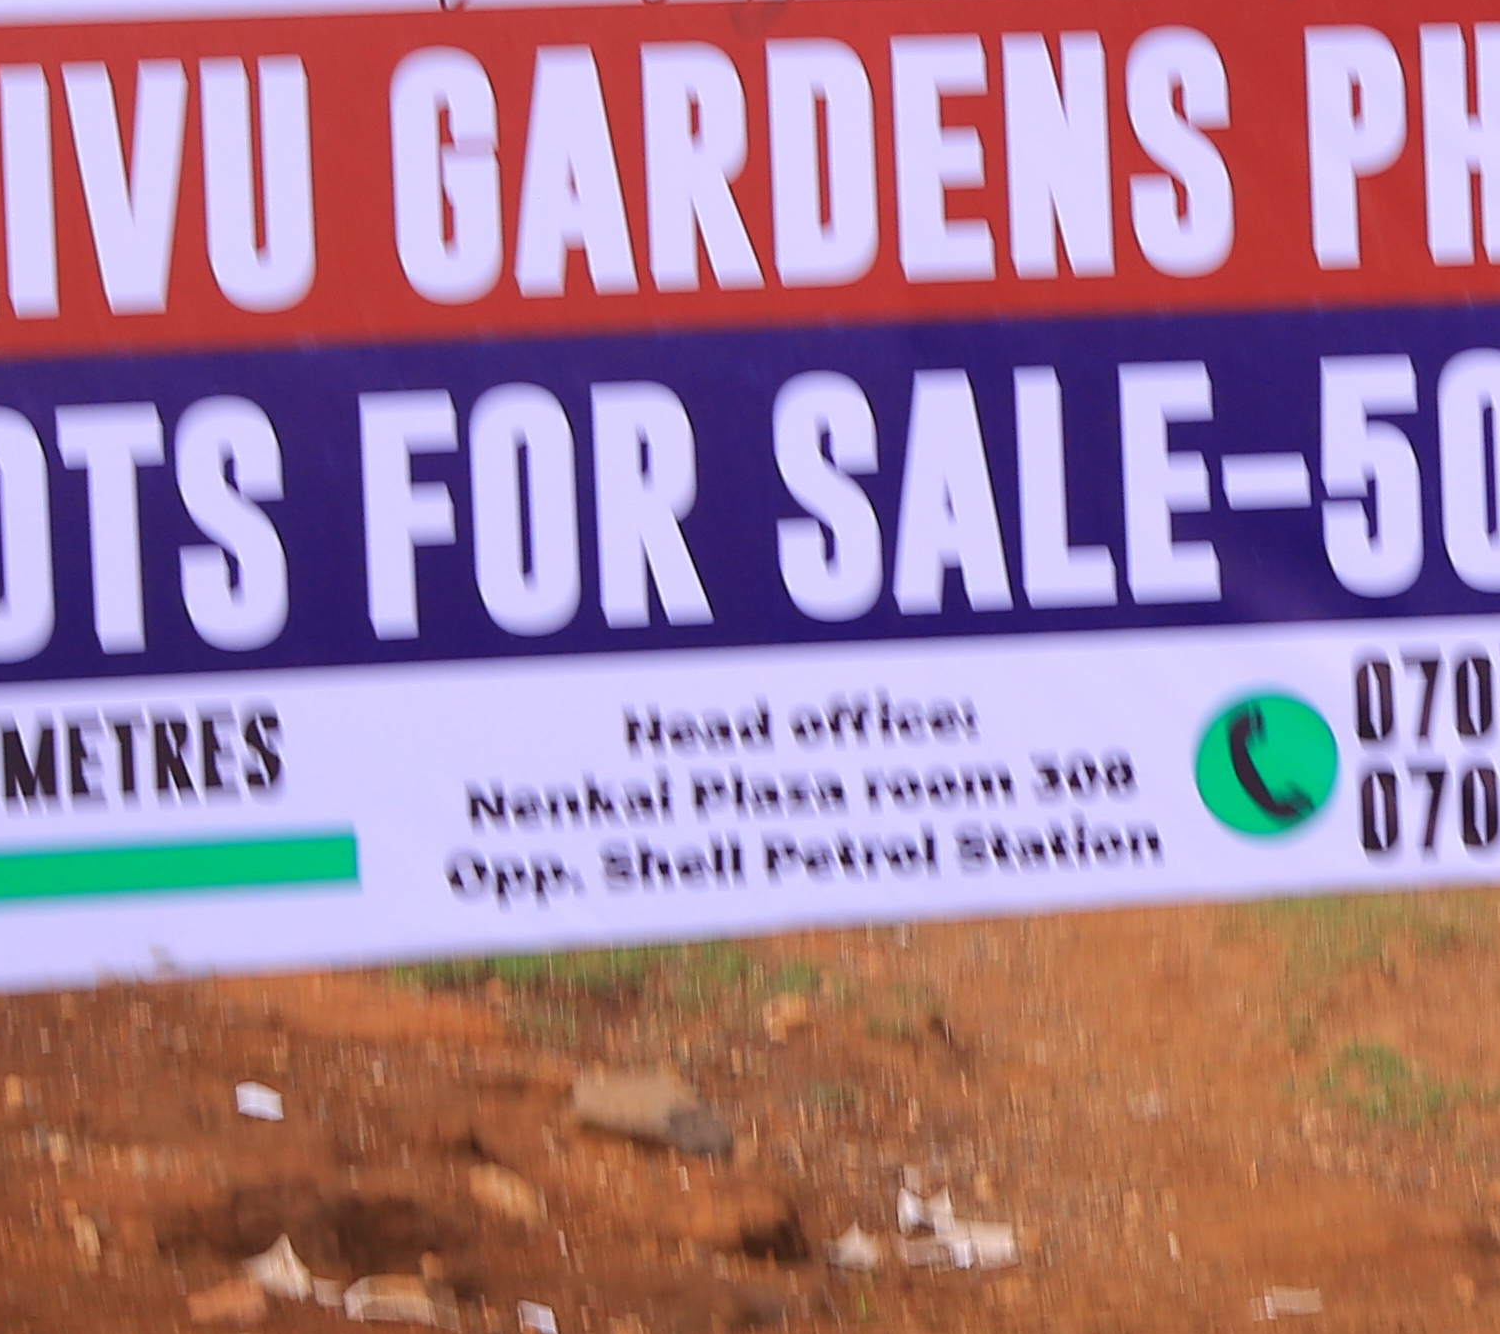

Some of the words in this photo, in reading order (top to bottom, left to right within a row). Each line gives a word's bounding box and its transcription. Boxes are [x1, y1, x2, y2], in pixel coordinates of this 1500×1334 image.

[388, 24, 1235, 305] GARDENS
[357, 380, 714, 641] FOR
[622, 701, 774, 754] Head
[690, 765, 850, 817] Plaza
[862, 764, 1018, 810] room
[445, 849, 586, 905] Opp.
[600, 833, 746, 892] Shell
[761, 821, 941, 884] Petrol
[954, 813, 1166, 875] Station
